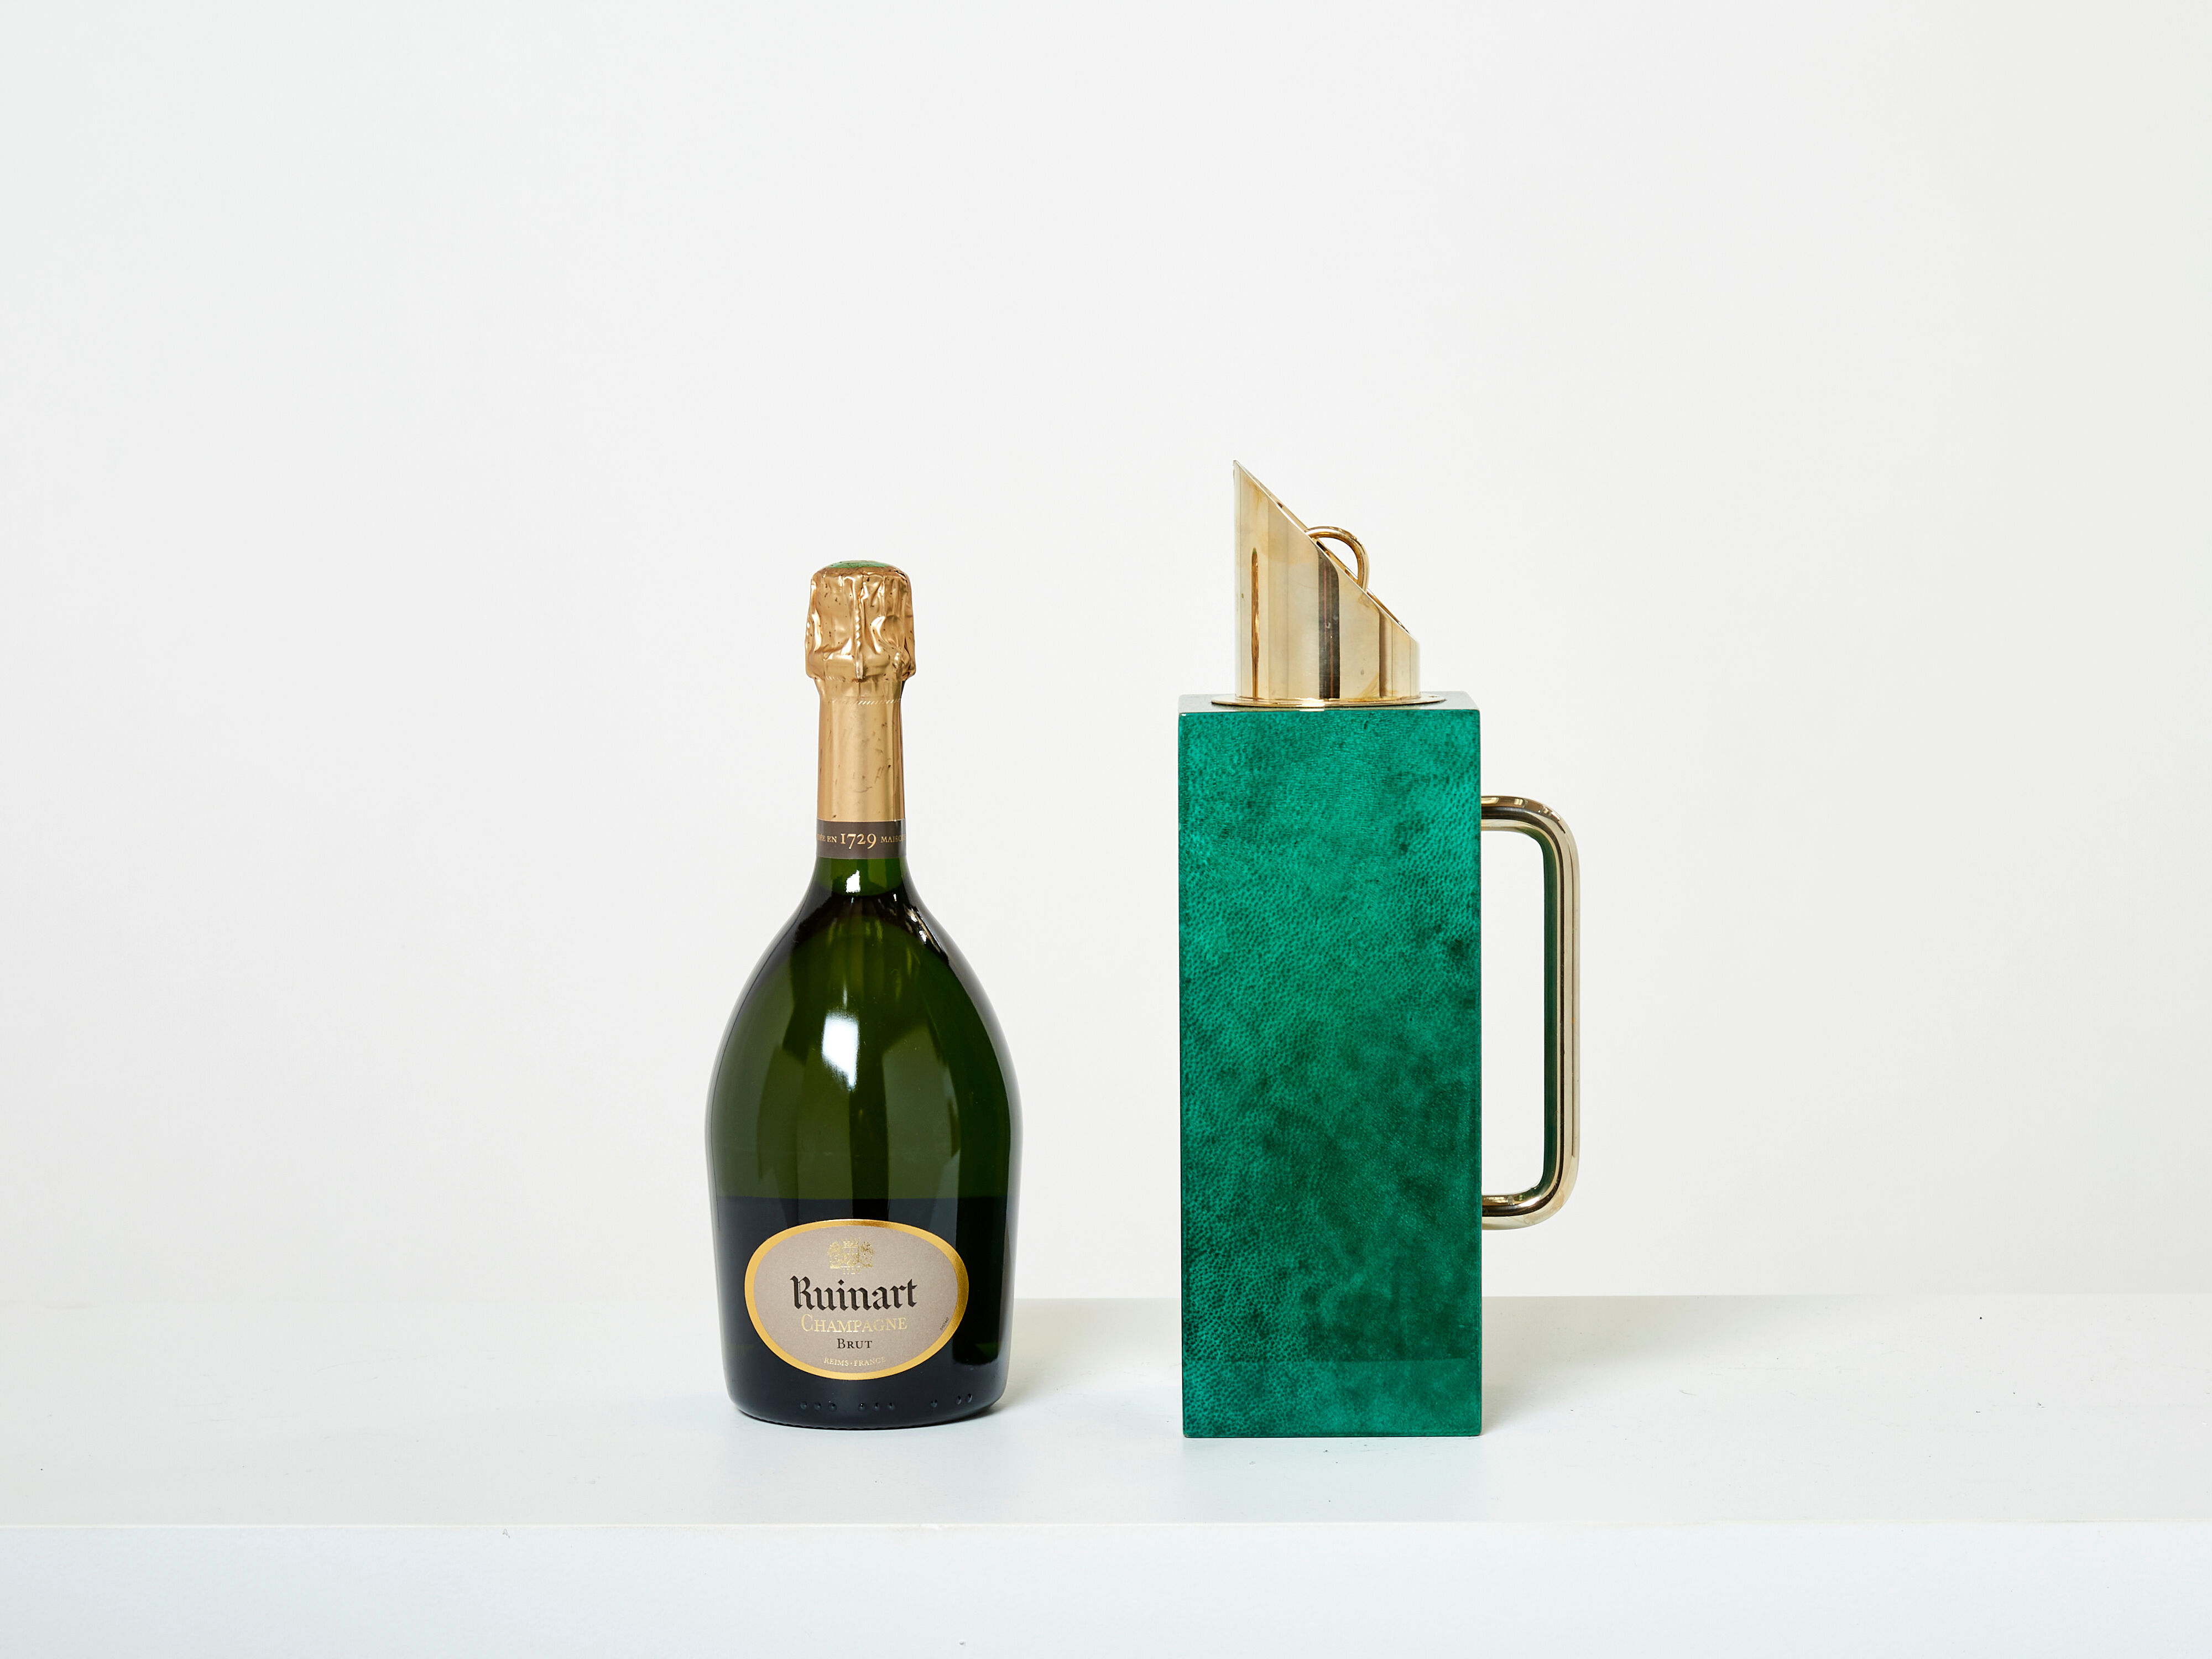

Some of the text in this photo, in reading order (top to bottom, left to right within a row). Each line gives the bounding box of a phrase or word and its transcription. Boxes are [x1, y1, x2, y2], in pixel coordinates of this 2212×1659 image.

[840, 833, 877, 849] 1729
[790, 1275, 917, 1311] Ruinart
[801, 1313, 907, 1333] CHAMPAGNE
[837, 1338, 873, 1349] BRUT
